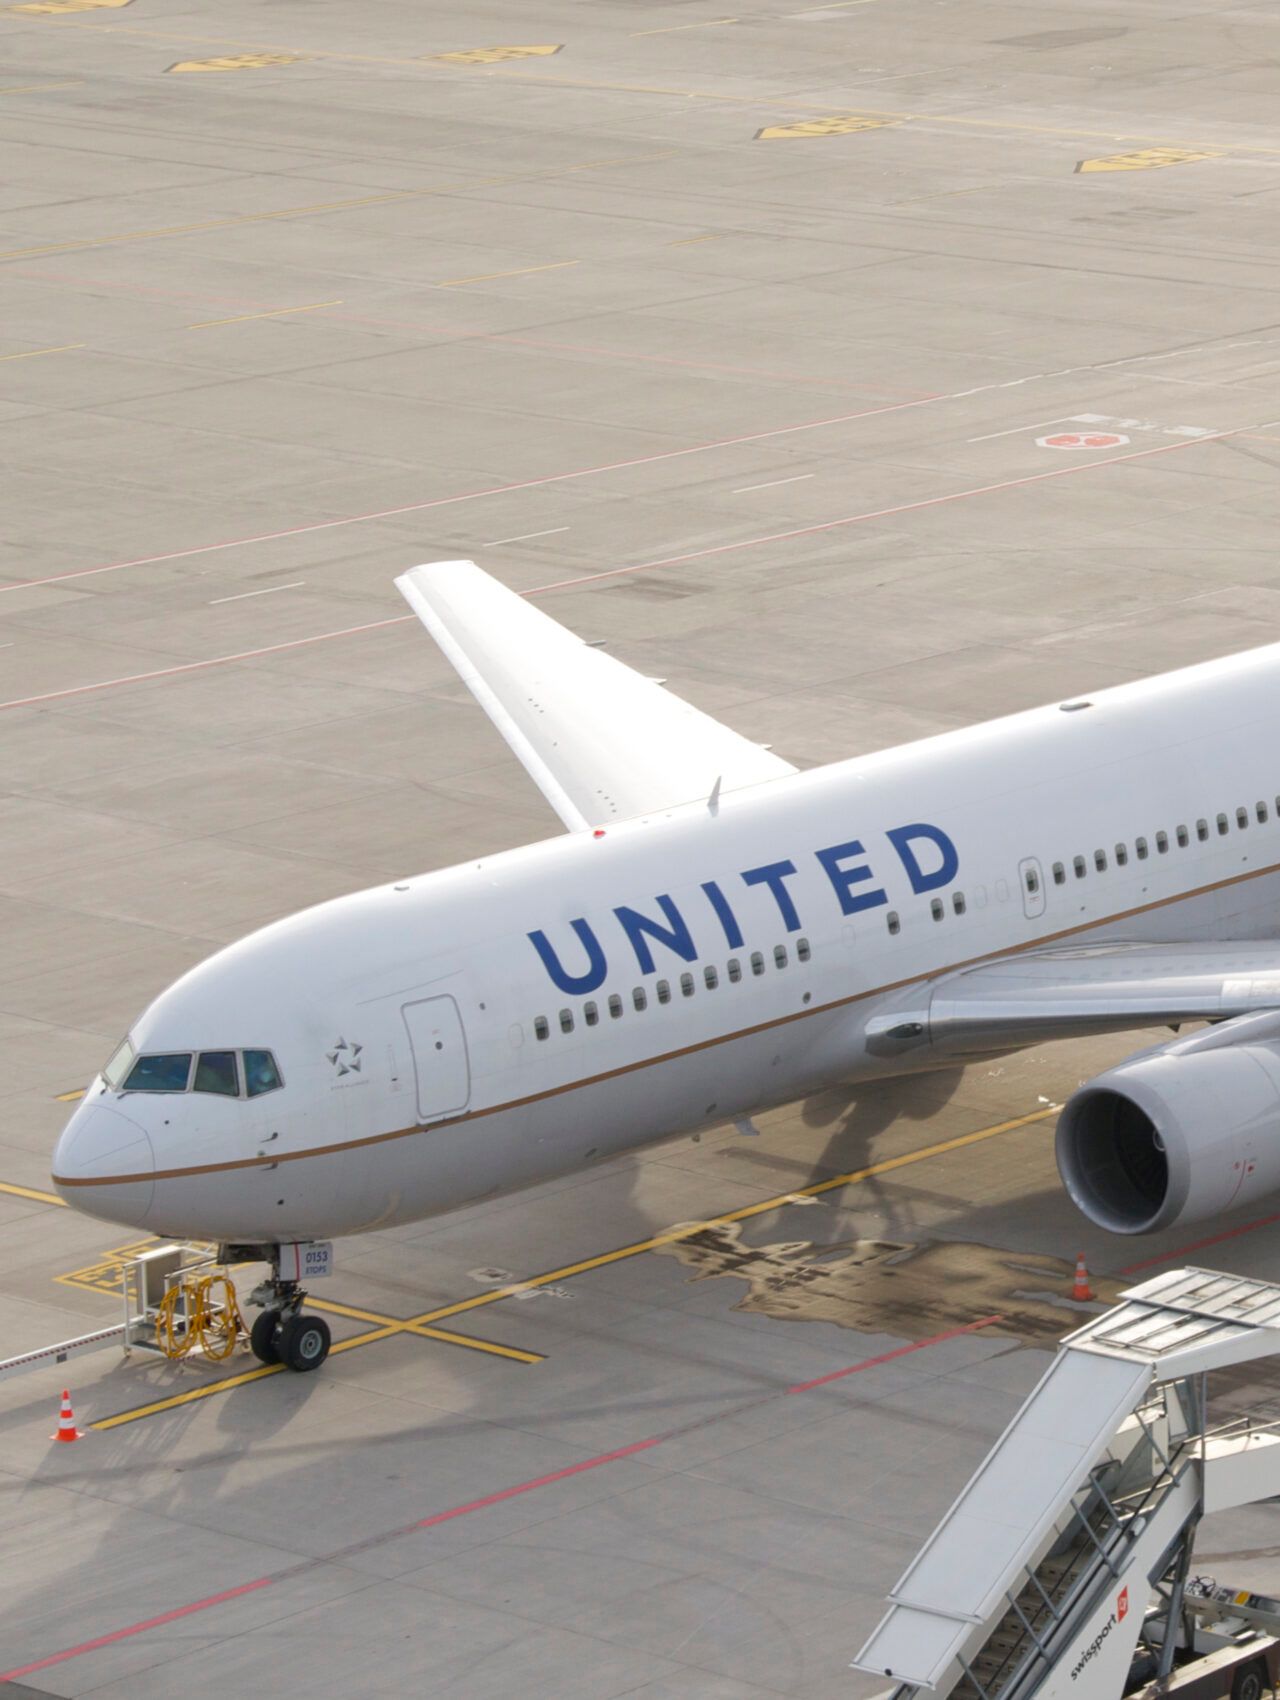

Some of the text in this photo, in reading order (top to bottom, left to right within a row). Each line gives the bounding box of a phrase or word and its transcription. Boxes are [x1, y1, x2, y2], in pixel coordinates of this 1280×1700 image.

[527, 823, 960, 995] UNITED
[305, 1250, 329, 1263] 0153
[1071, 1612, 1117, 1681] swissport
